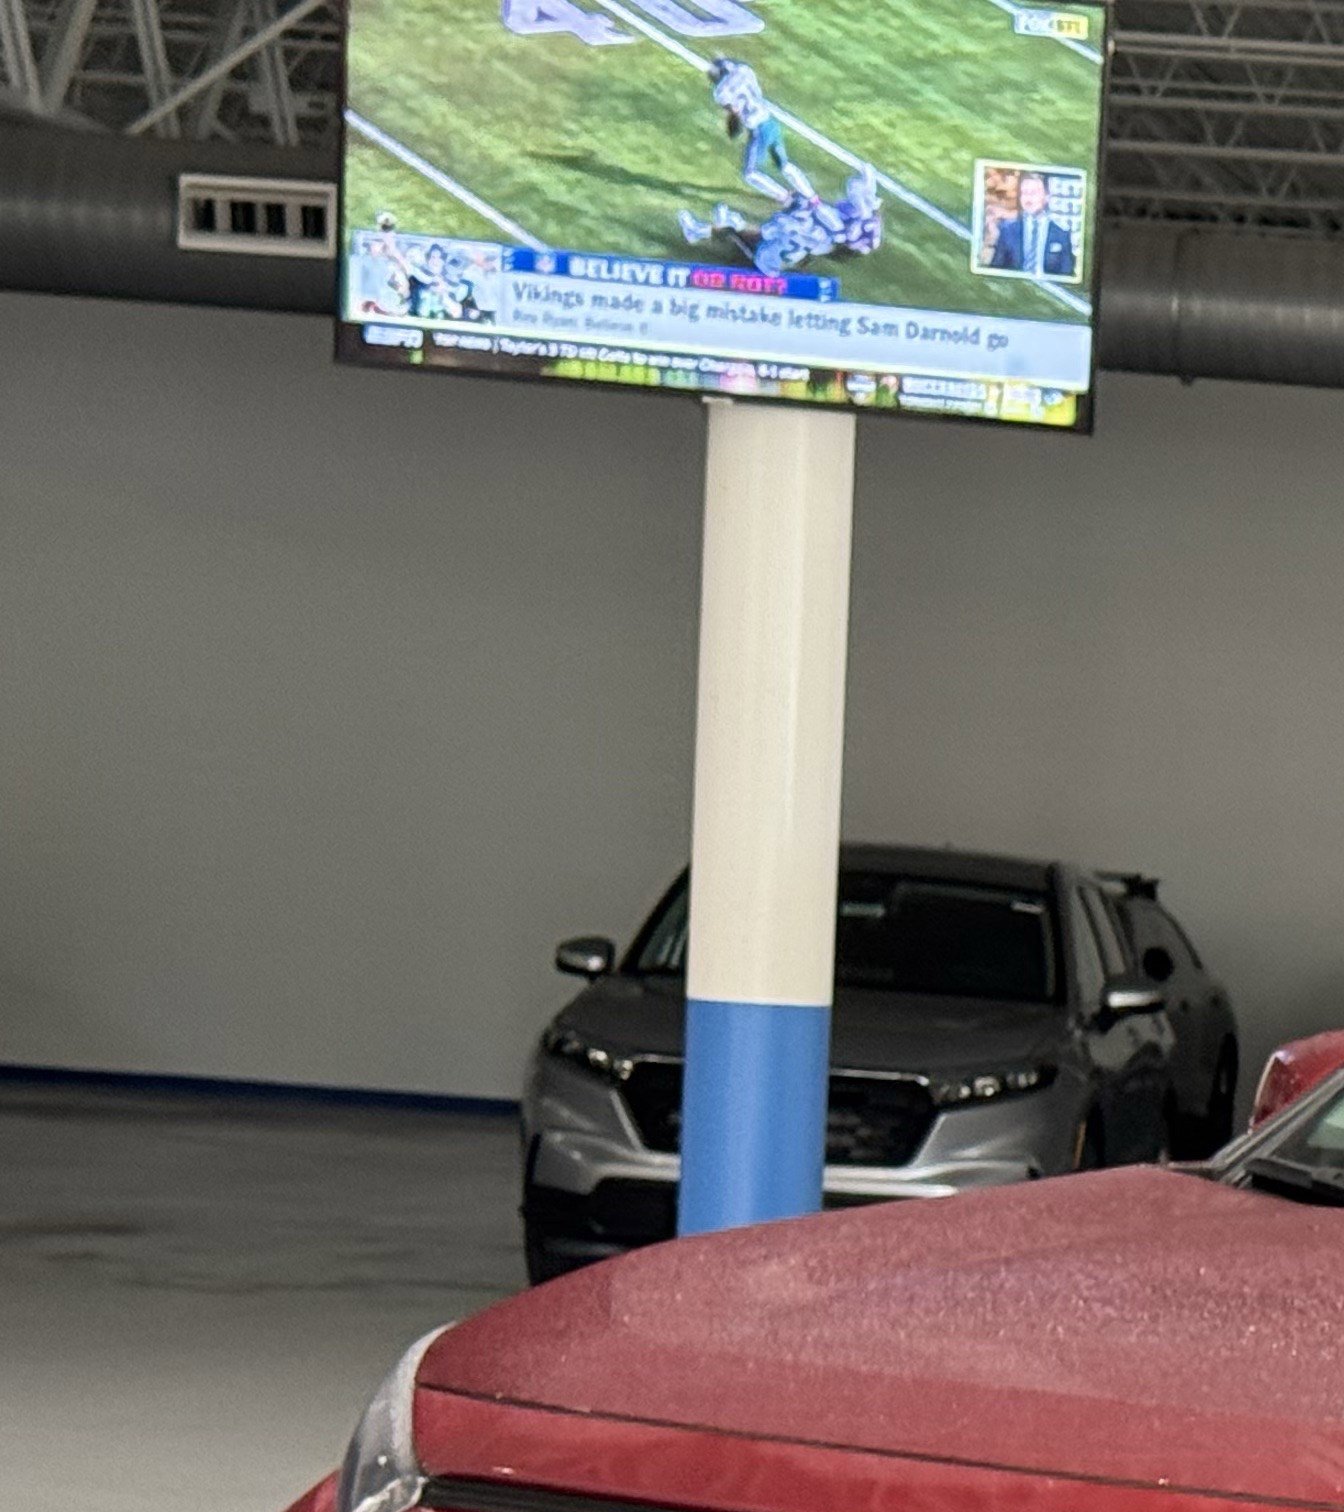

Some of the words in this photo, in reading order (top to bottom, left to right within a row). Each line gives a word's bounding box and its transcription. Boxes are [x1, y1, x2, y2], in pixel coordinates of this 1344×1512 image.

[568, 255, 665, 285] BELIEVE
[667, 267, 691, 288] IT
[512, 281, 585, 309] Vikings
[591, 292, 645, 313] made
[651, 300, 664, 314] a
[669, 297, 700, 323] big
[706, 302, 783, 327] mistake
[787, 308, 852, 337] letting
[857, 316, 899, 337] Sam
[905, 320, 981, 345] Darnold
[986, 332, 1009, 351] go
